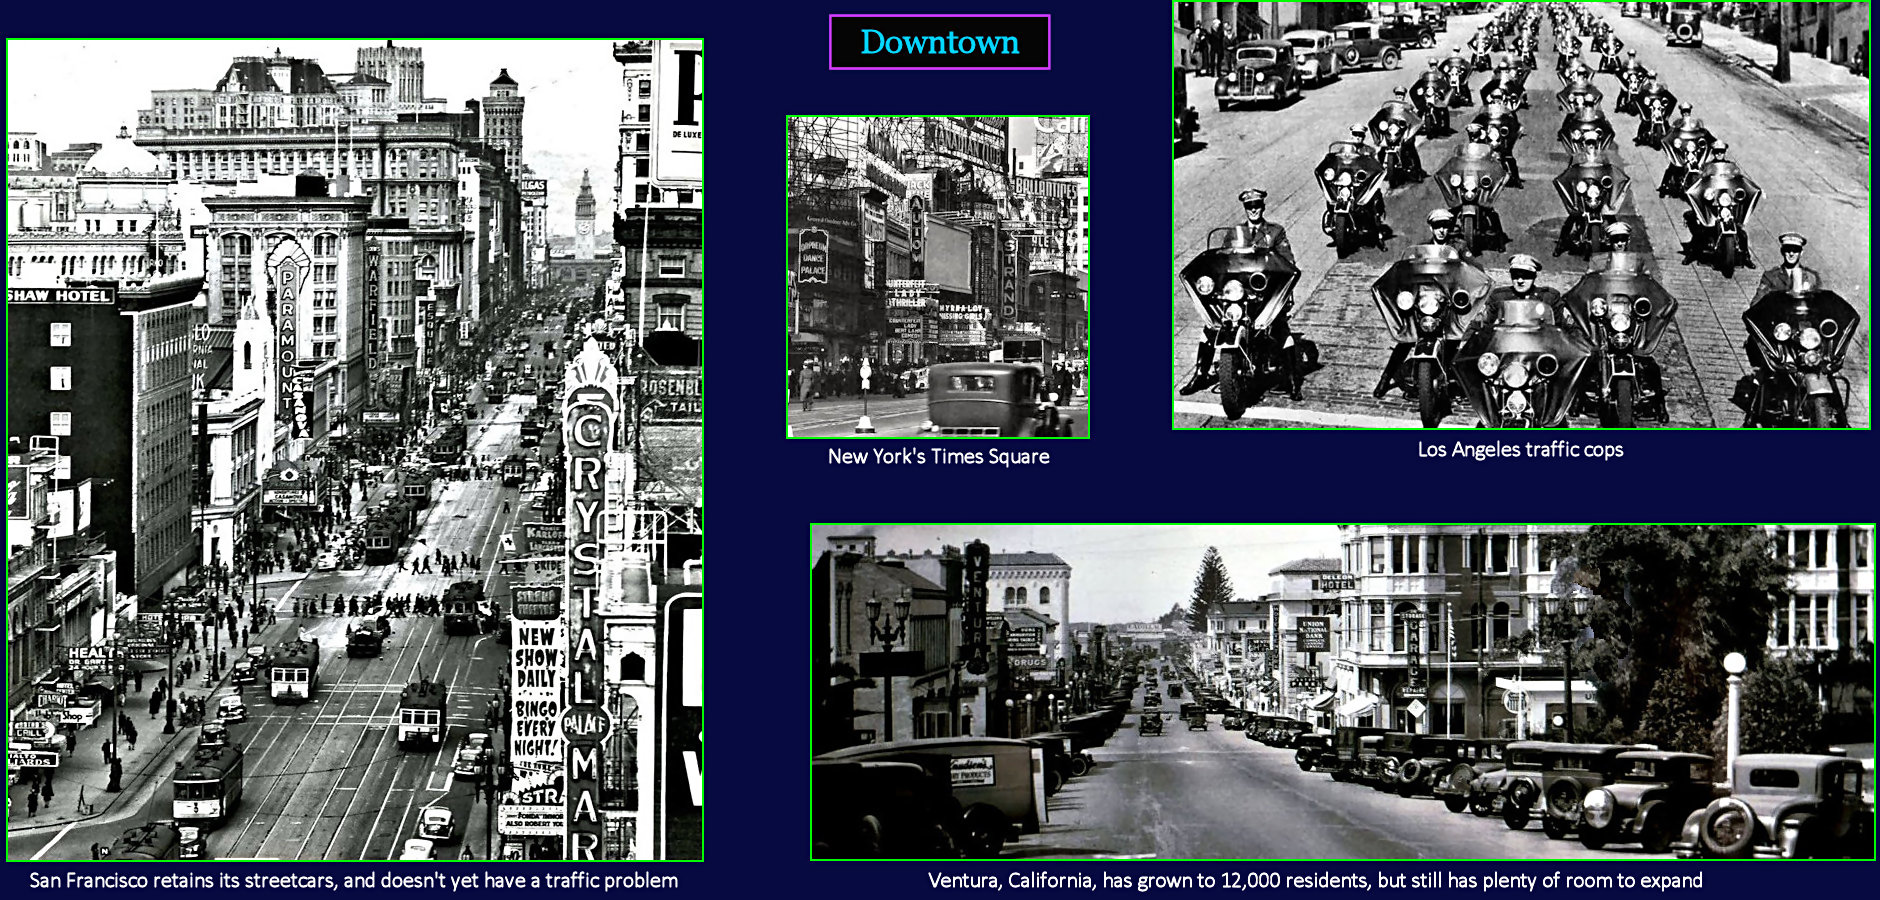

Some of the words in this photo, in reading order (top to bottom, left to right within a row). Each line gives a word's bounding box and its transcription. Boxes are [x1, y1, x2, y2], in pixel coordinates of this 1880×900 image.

[803, 254, 825, 262] DANCE
[801, 266, 826, 275] PALACE
[1003, 239, 1016, 316] STRAND
[56, 290, 110, 301] HOTEL
[895, 289, 921, 297] LADY
[369, 254, 379, 370] WARFIELD
[281, 271, 295, 409] PARAMOUNT
[292, 376, 309, 438] CASANOVA
[573, 414, 603, 704] CRYSTAL
[1321, 581, 1354, 589] HOTEL
[973, 555, 982, 659] VENTURA
[519, 628, 555, 645] NEW
[515, 649, 557, 667] SHOW
[1014, 658, 1046, 666] DRUGS
[1410, 621, 1419, 687] GARAGE
[518, 670, 556, 687] DAILY
[63, 710, 82, 722] Shop
[515, 701, 557, 717] BINGO
[517, 720, 556, 737] EVERY
[563, 713, 606, 736] PALACE
[514, 739, 558, 756] NIGHT!
